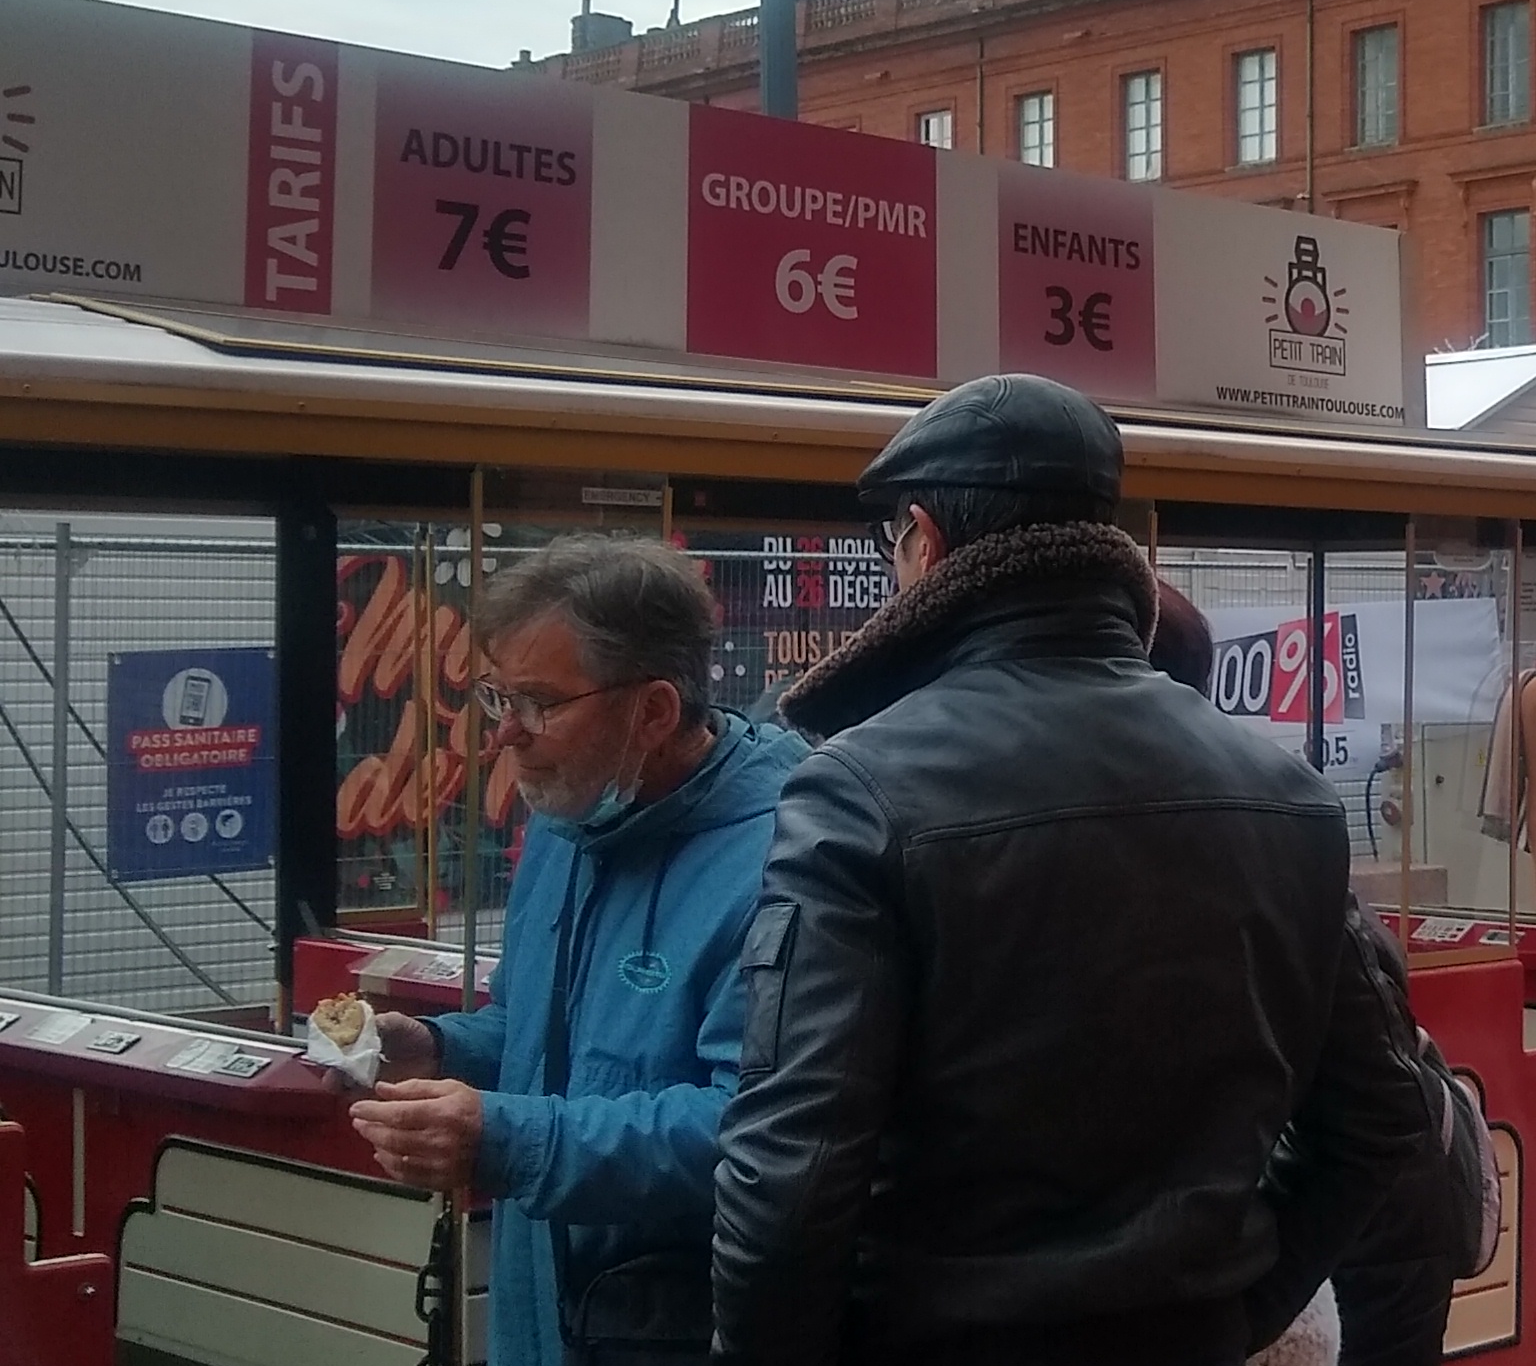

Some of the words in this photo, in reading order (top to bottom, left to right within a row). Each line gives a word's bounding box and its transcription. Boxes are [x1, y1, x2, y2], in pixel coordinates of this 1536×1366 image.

[400, 129, 577, 186] ADULTES
[266, 60, 325, 302] TARIFS
[701, 173, 927, 238] GROUPE/PMR
[435, 199, 532, 279] 7€
[1013, 223, 1141, 271] ENFANTS
[775, 249, 859, 320] 6€
[1044, 286, 1114, 352] 3€
[1273, 338, 1303, 362] PETIT
[1309, 342, 1342, 366] TRAIN
[1216, 386, 1405, 420] WWW.PETITTRAINTOULOUSE.COM
[584, 490, 651, 503] EMERGENCY
[763, 537, 792, 570] DU
[763, 574, 792, 608] AU
[763, 631, 821, 664] TOUS
[1343, 633, 1361, 699] radio
[132, 734, 170, 749] PASS
[173, 729, 257, 747] SANITAIRE
[140, 749, 248, 768] OBLIGATOIRE
[136, 803, 154, 812] LES
[157, 800, 194, 812] GESTES
